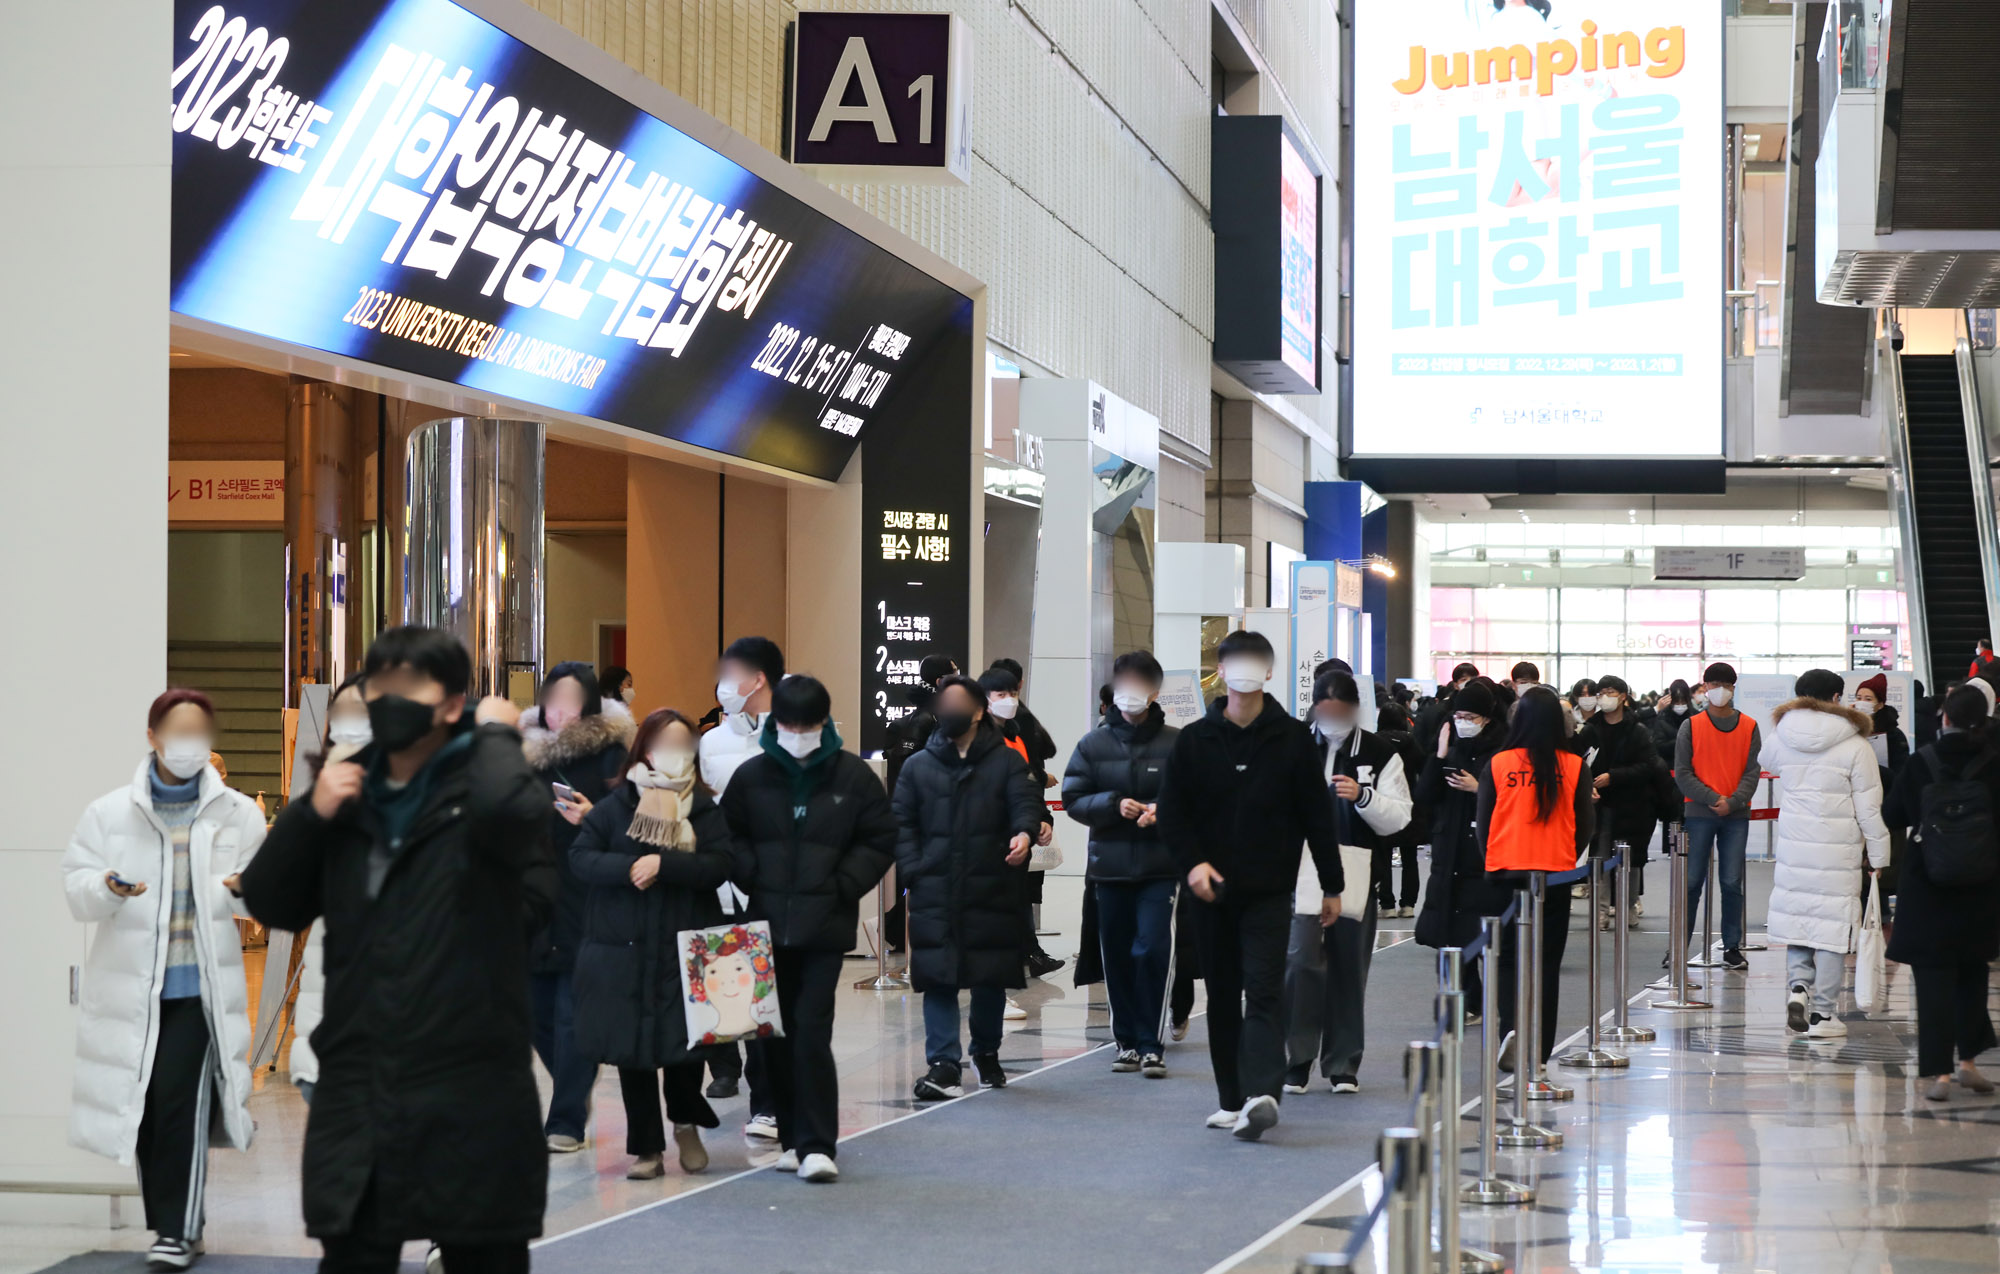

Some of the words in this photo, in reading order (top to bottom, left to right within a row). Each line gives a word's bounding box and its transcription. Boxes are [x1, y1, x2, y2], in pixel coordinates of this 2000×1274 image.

[1391, 19, 1685, 96] Jumping
[807, 36, 933, 144] A1
[1391, 93, 1684, 222] 남서울
[716, 228, 793, 319] 정시
[1391, 204, 1684, 330] 대학교
[342, 286, 393, 329] 2023
[380, 296, 469, 350] UNIVERSITY
[454, 318, 521, 367] REGULAR
[510, 336, 585, 384] ADMISSIONS
[571, 356, 606, 390] FAIR
[750, 321, 801, 378] 2022.
[1398, 357, 1428, 372] 2023
[1502, 408, 1604, 424] 남서울대학교
[189, 479, 213, 500] B1
[217, 479, 260, 492] 스타필드
[883, 511, 914, 529] 전시장
[915, 512, 936, 530] 관람
[938, 514, 949, 531] 시
[881, 534, 911, 560] 필수
[915, 535, 950, 561] 사항!
[1726, 553, 1744, 569] 1F
[877, 600, 886, 624] 1
[886, 615, 912, 630] 마스크
[913, 616, 931, 631] 착용
[1617, 633, 1652, 649] East
[1655, 633, 1695, 649] Gate
[875, 690, 887, 718] 3
[1507, 771, 1564, 788] STA
